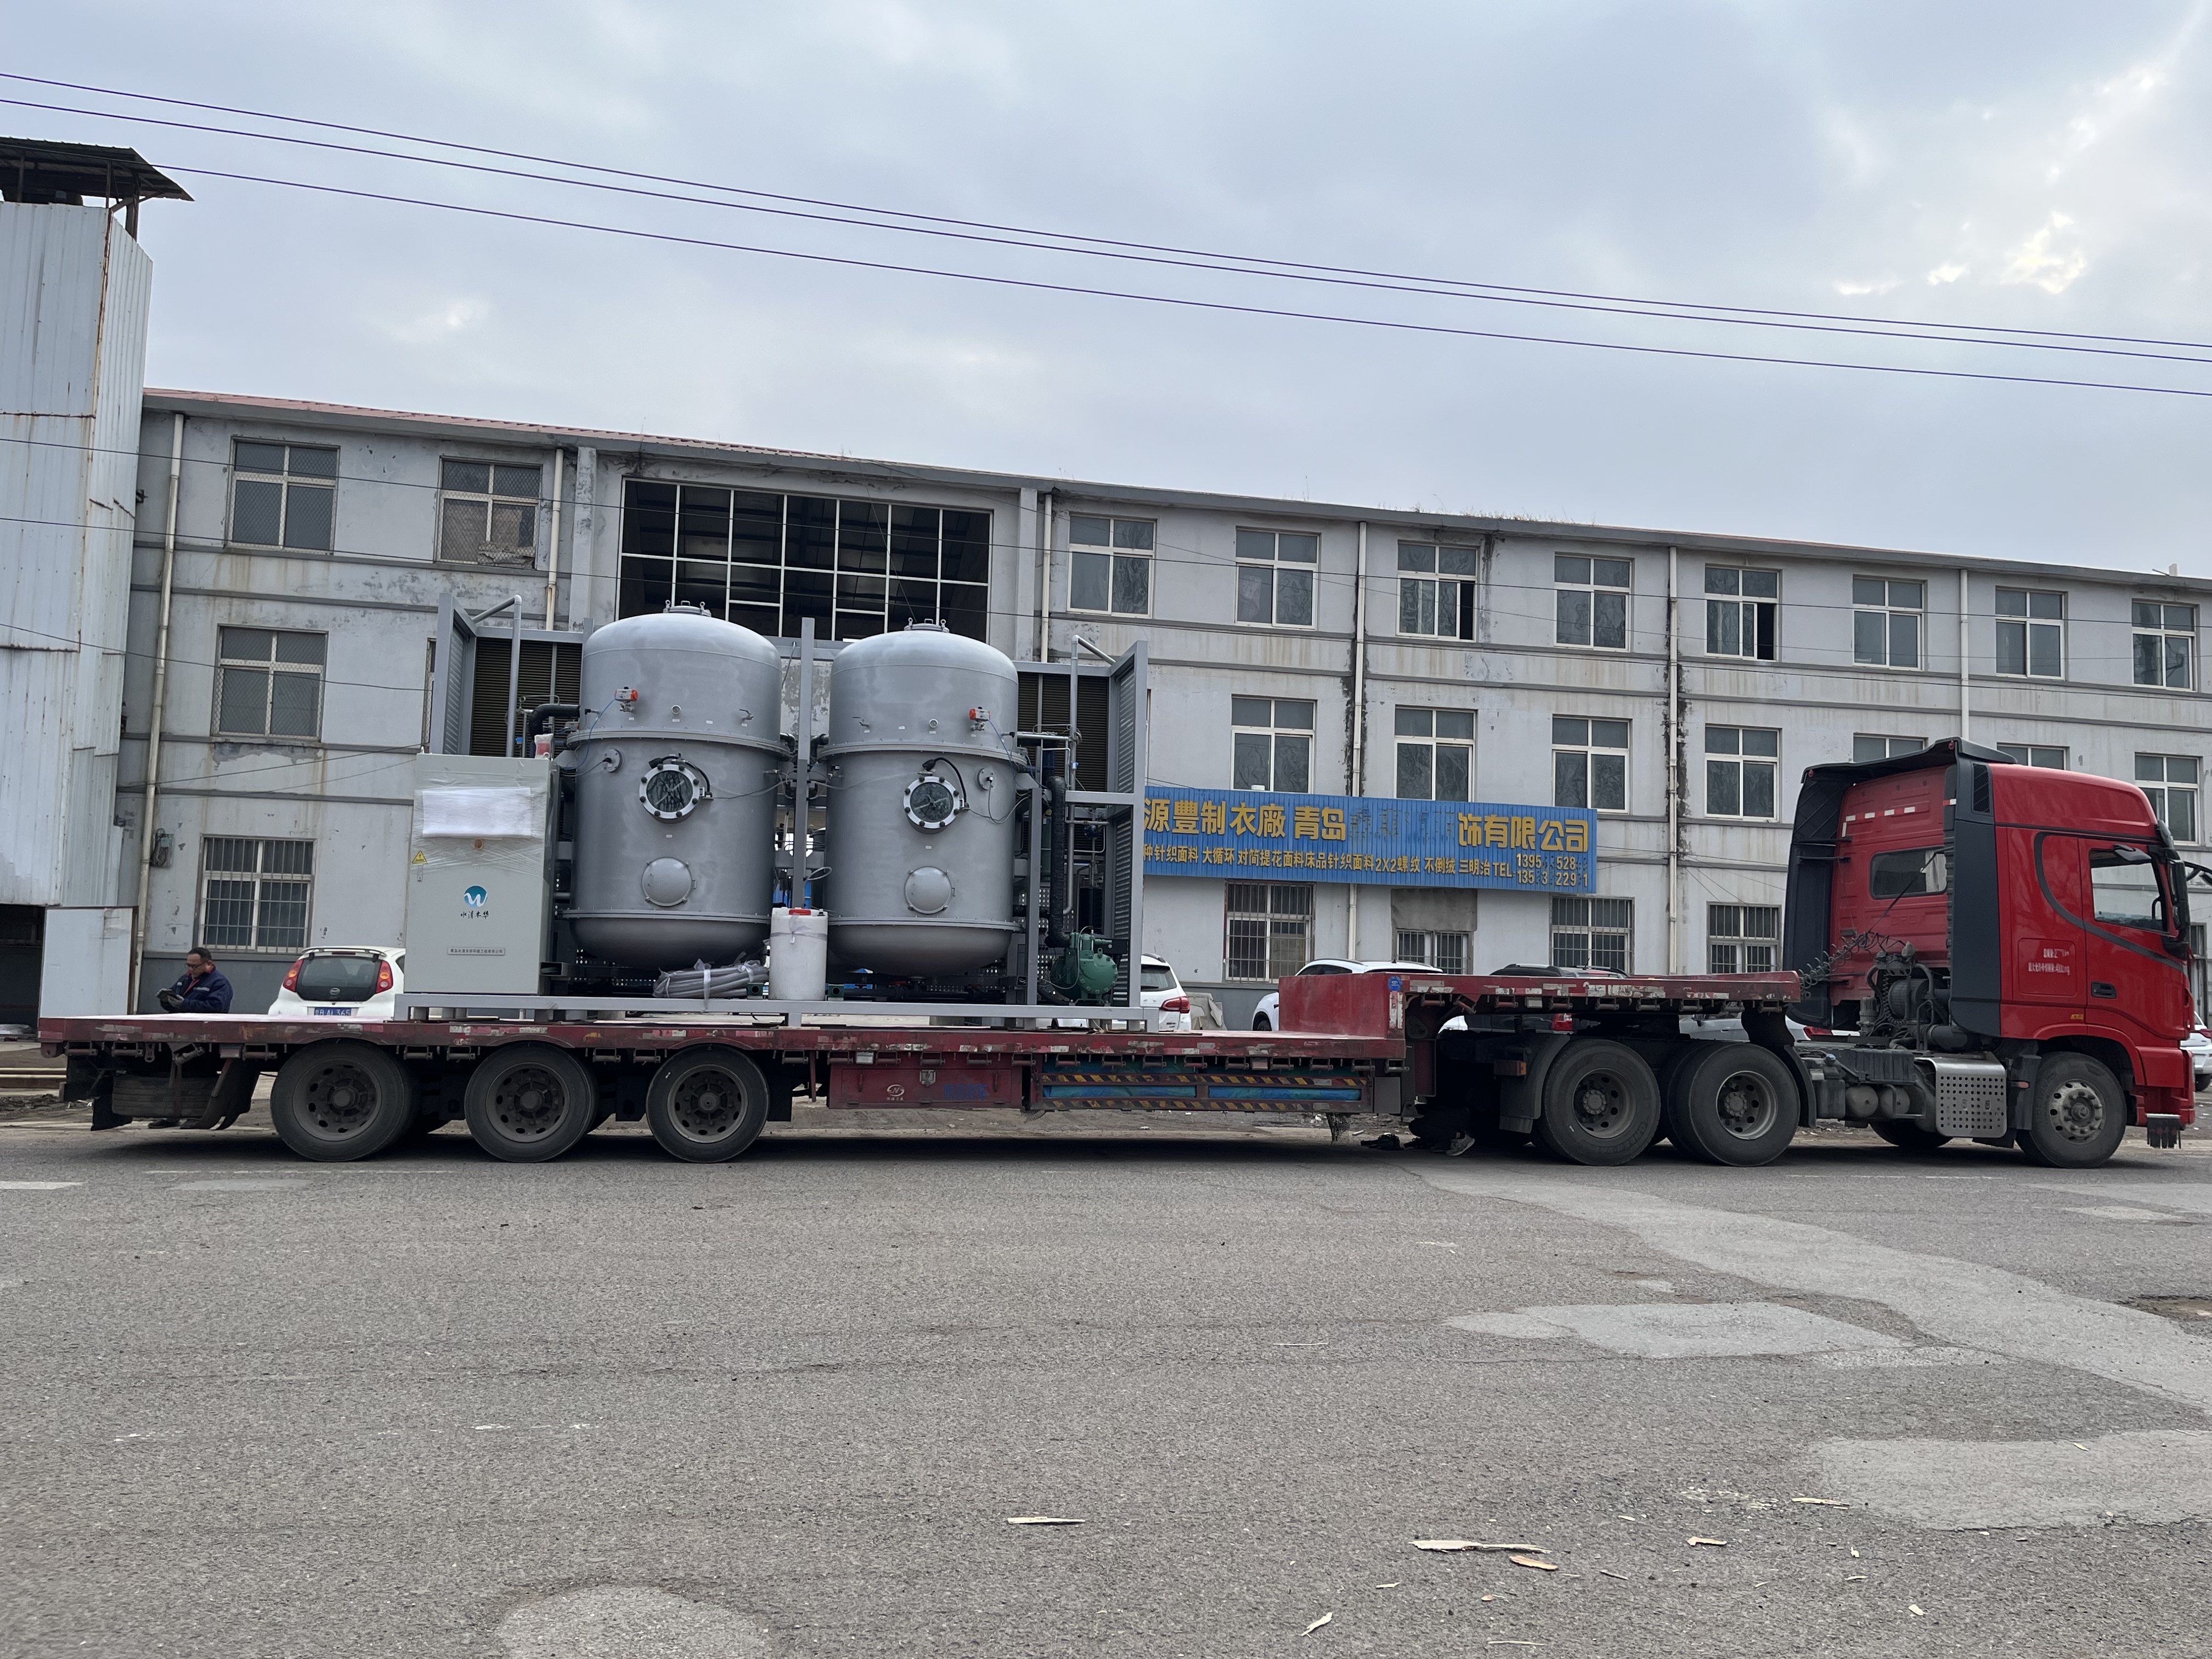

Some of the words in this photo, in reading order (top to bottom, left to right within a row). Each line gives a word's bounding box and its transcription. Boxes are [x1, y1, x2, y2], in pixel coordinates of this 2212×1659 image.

[1294, 805, 1346, 840] 青岛
[1458, 812, 1588, 852] 饰有限公司
[1203, 846, 1235, 865] 大循环
[1424, 856, 1455, 874] 不倒绒
[1459, 859, 1490, 876] 三明治
[1517, 853, 1542, 868] 1395
[1556, 856, 1576, 870] 528
